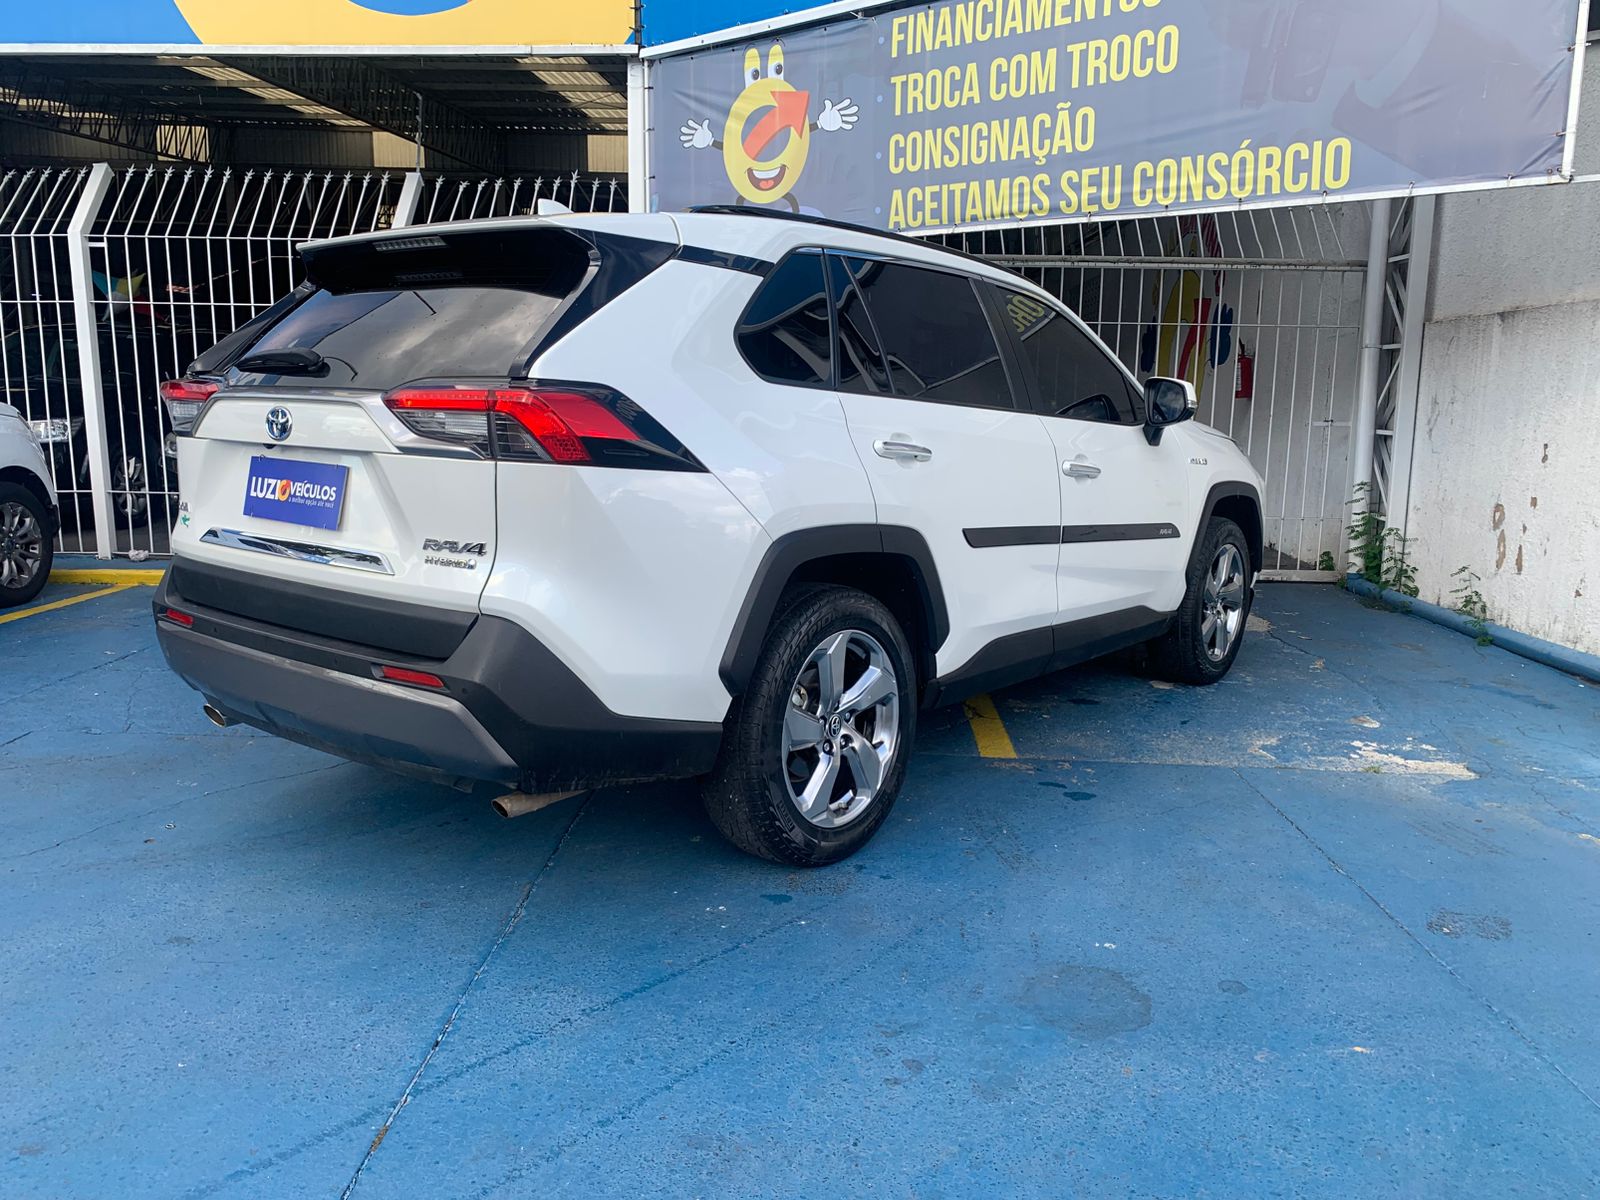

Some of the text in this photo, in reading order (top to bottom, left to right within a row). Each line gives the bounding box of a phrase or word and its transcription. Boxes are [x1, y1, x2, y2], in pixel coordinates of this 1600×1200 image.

[889, 0, 1161, 57] FINANCIAMEN
[891, 25, 1178, 115] TROCA COM TROCO
[889, 102, 1096, 174] CONSIGNAÇÃO
[888, 137, 1352, 229] ACEITAMOS SEU CONSÓRCIO
[290, 480, 337, 501] VEÍCULOS
[422, 538, 487, 557] RAV4
